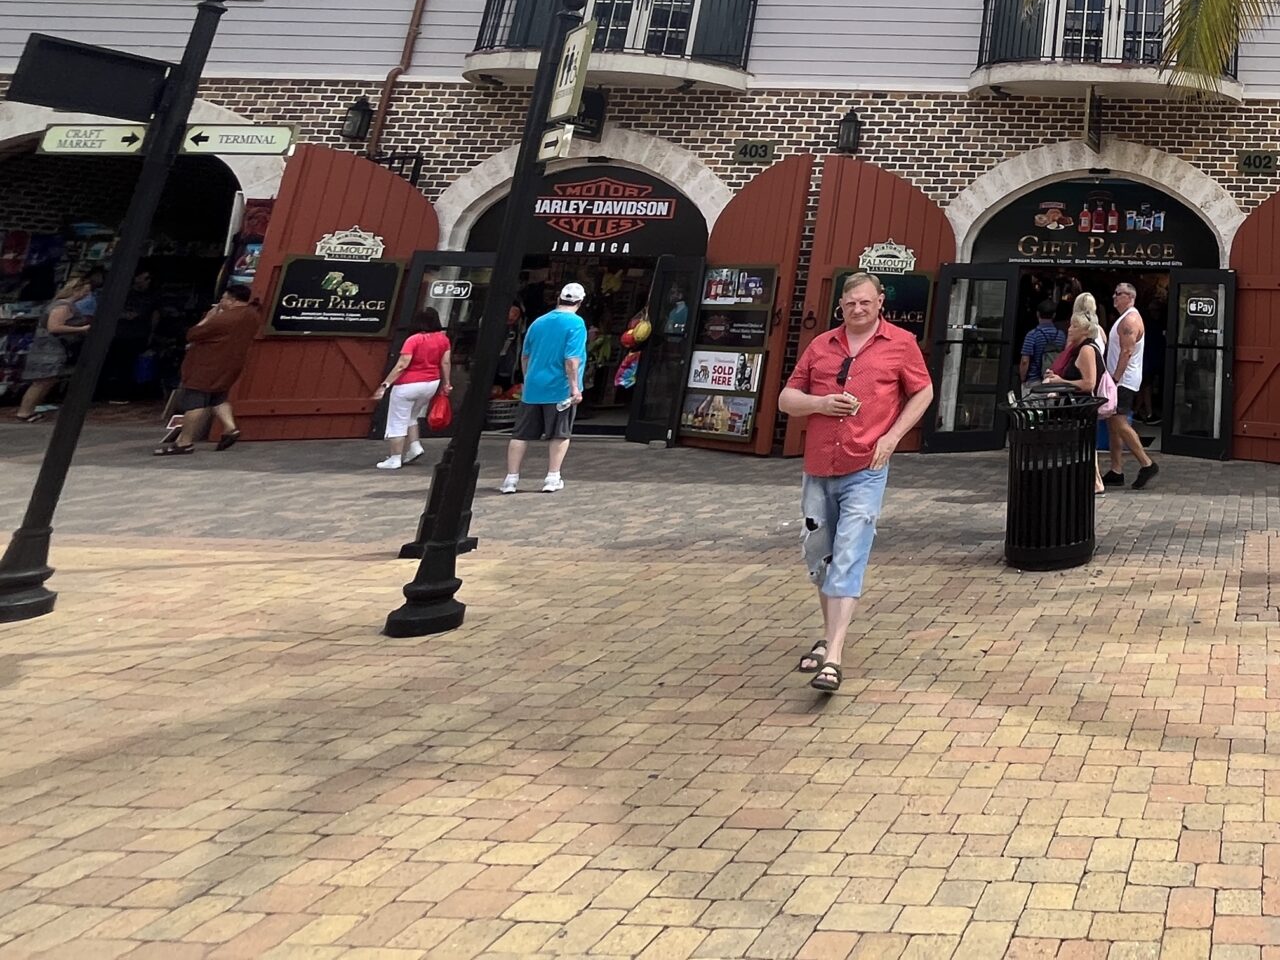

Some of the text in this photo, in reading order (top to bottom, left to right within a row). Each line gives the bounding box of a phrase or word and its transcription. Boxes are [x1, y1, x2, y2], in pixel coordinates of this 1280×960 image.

[65, 129, 104, 138] CRAFT
[218, 134, 277, 144] TERMINAL
[57, 139, 107, 148] MARKET
[739, 144, 768, 158] 403
[1243, 155, 1272, 169] 402
[565, 182, 639, 197] MOTOR
[558, 218, 633, 237] CYCLES
[320, 245, 379, 255] FALMOUTH
[551, 241, 631, 254] JAMAICA
[1017, 234, 1175, 259] GIFT PALACE
[861, 258, 912, 269] FALMOUTH
[445, 284, 469, 296] Pay
[281, 293, 386, 311] GIFT PALACE
[1197, 302, 1213, 315] Pay
[711, 365, 734, 376] SOLD
[710, 375, 733, 386] HERE
